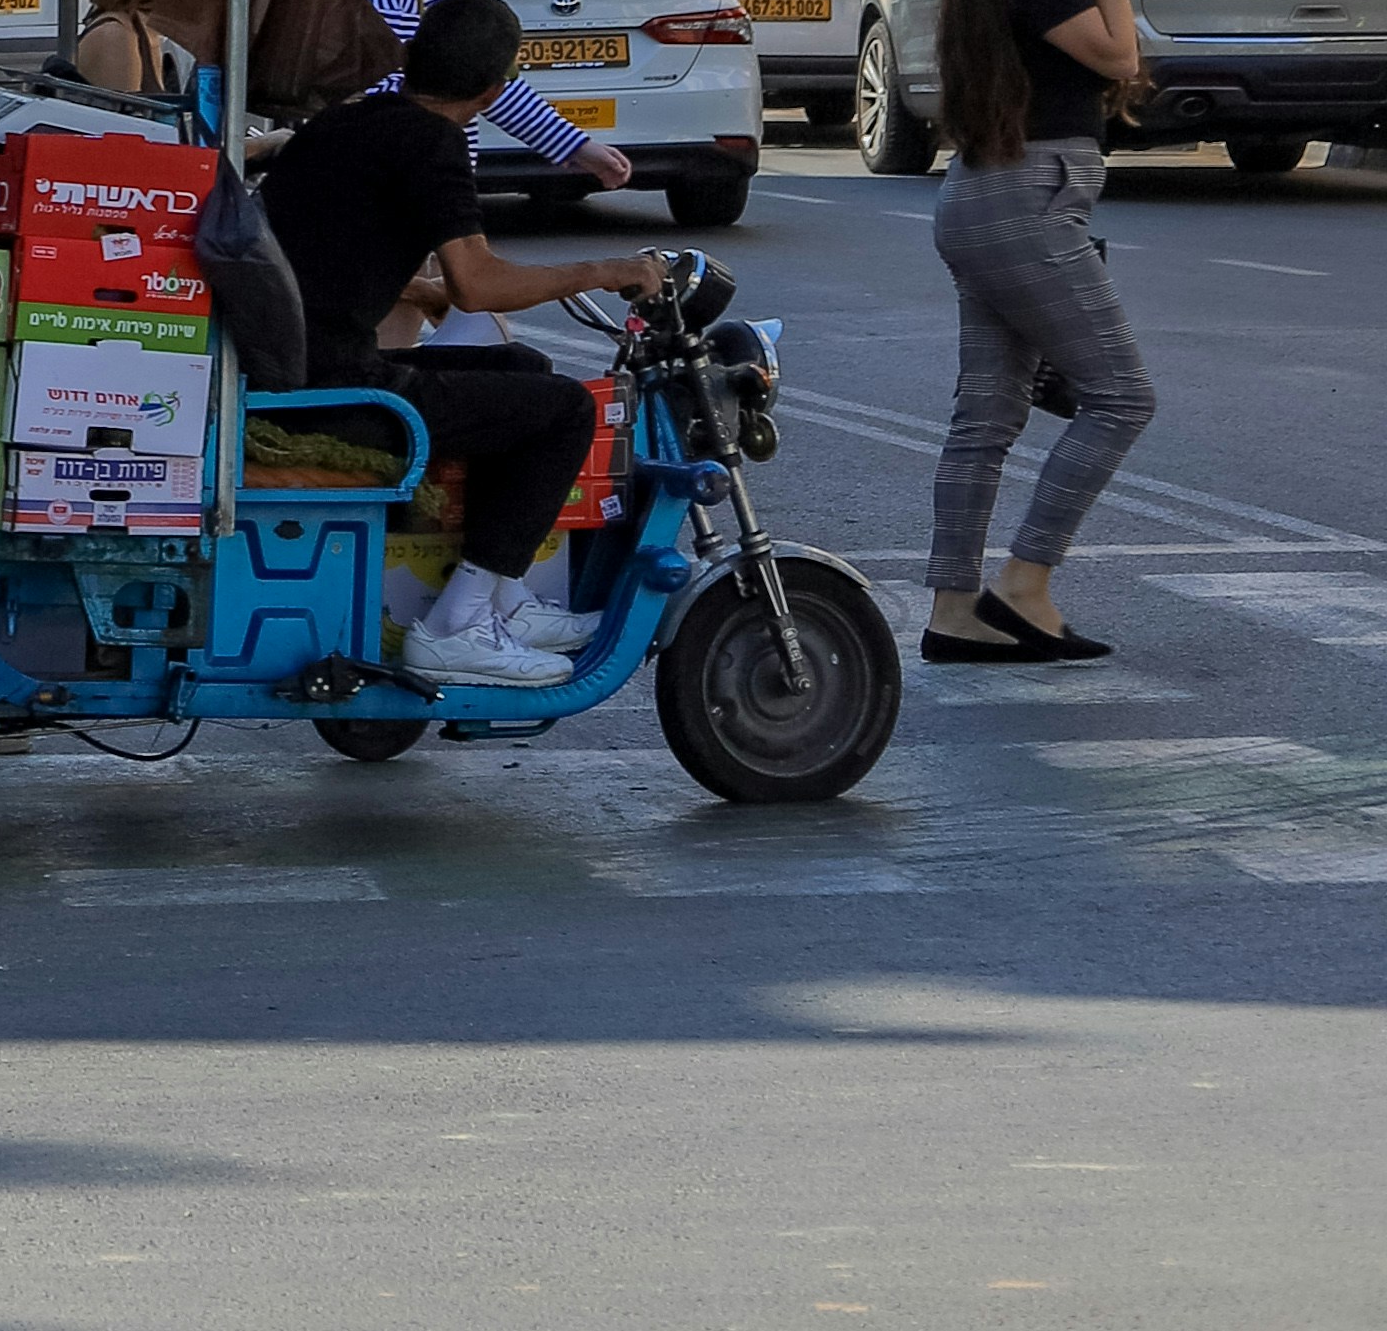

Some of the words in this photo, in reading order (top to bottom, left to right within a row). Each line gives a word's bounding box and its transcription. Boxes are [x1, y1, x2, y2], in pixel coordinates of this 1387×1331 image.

[29, 312, 69, 328] טריים
[70, 316, 112, 332] איכות
[117, 317, 155, 335] פירות
[156, 322, 196, 339] שיווק
[47, 387, 90, 403] דדוש
[96, 393, 141, 407] אחים
[116, 462, 165, 480] פירות
